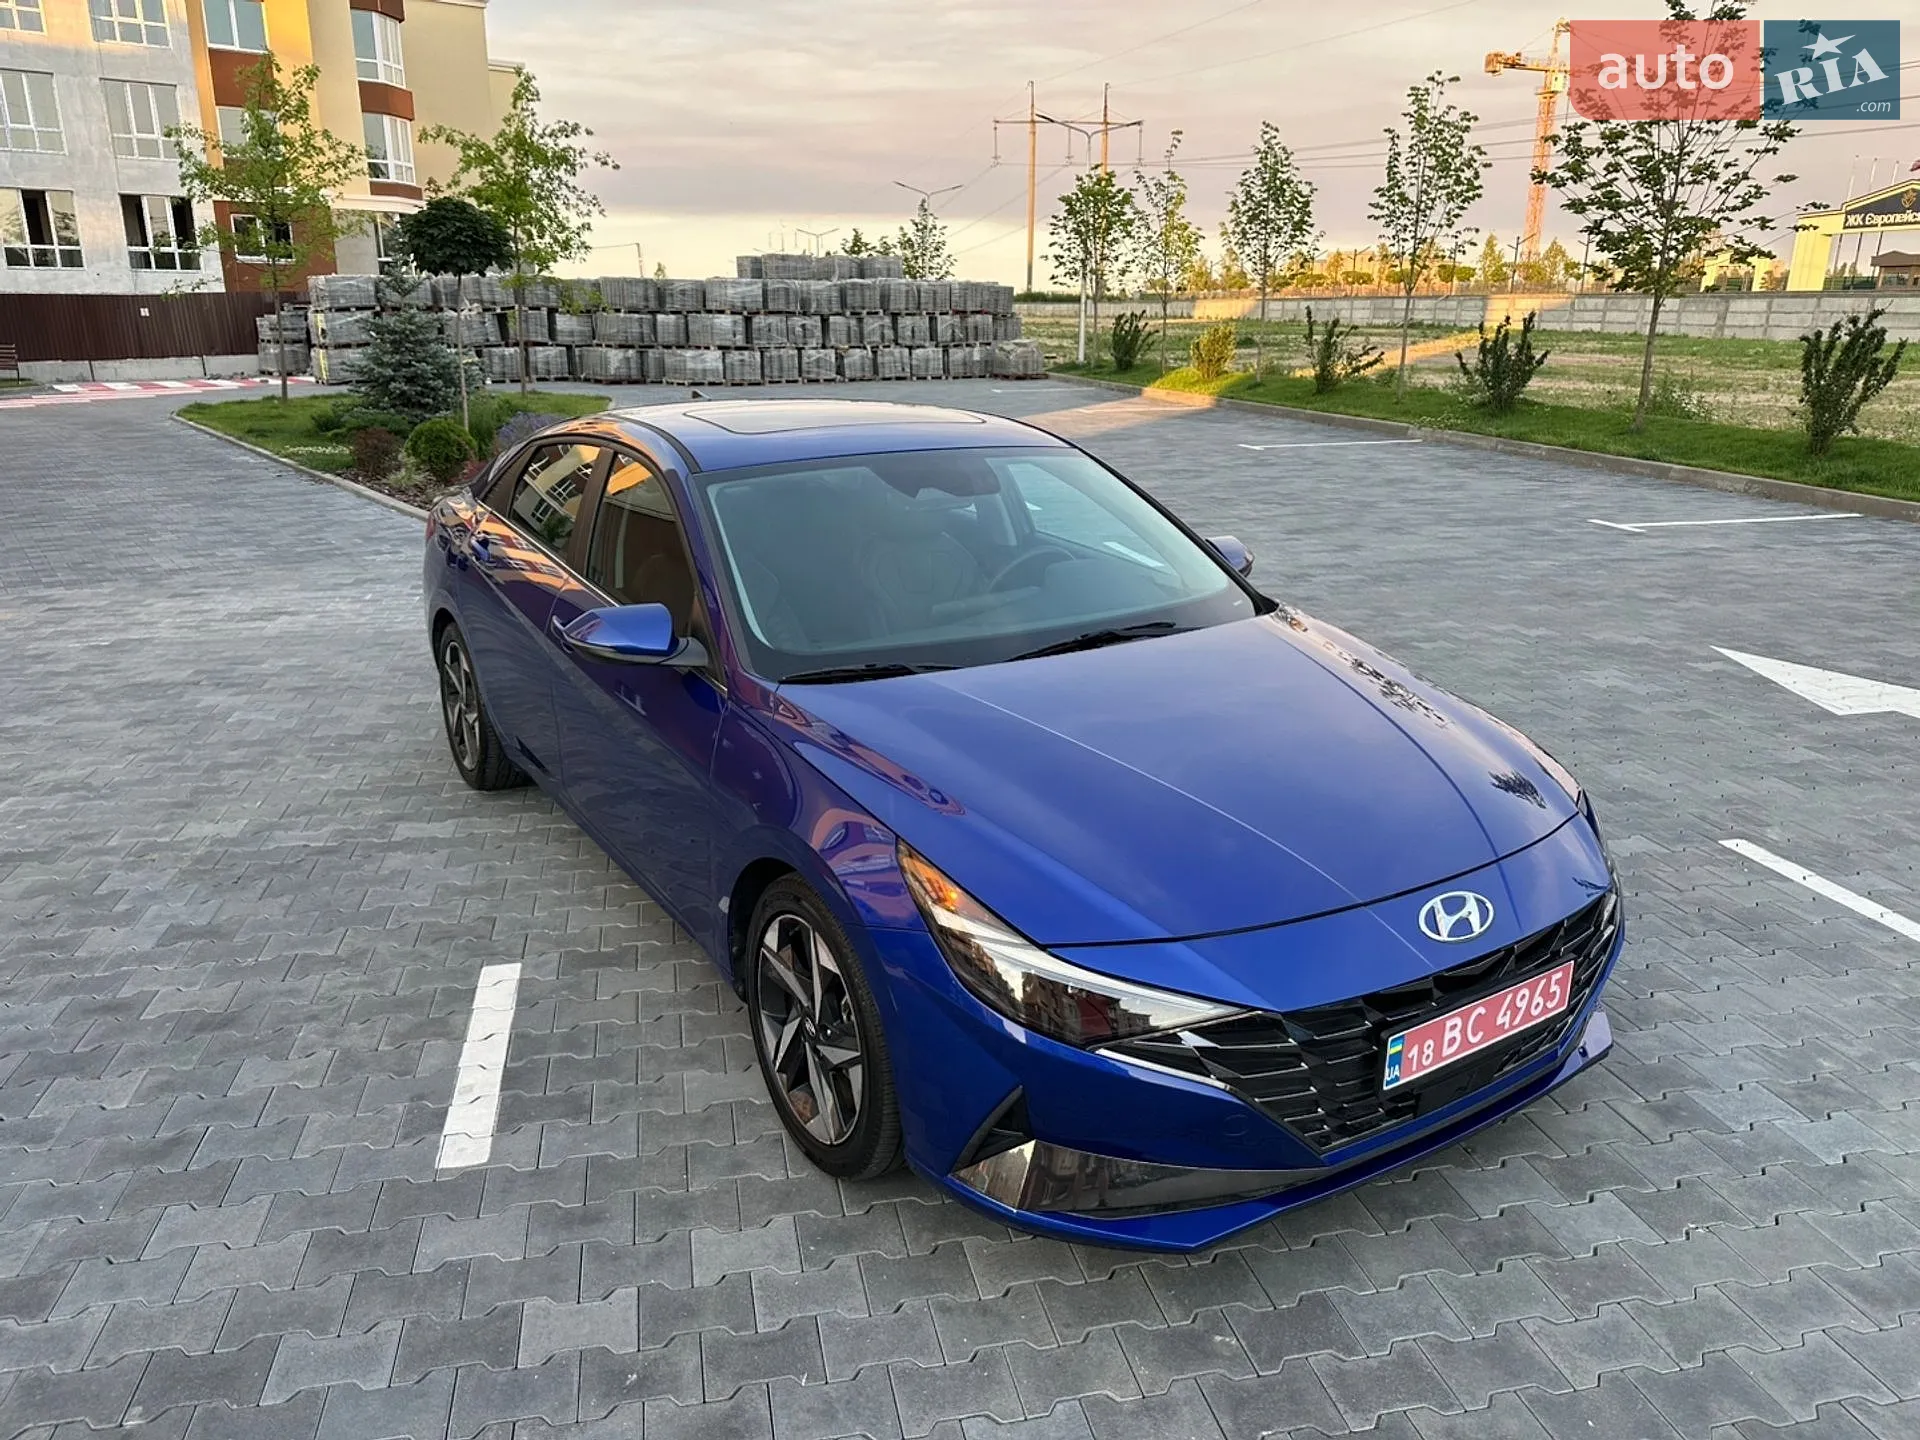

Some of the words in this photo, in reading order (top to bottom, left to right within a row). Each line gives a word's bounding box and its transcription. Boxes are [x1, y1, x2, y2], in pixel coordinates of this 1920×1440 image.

[1865, 210, 1920, 228] Європейс
[1407, 1039, 1434, 1071] 18
[1441, 1006, 1487, 1057] BC
[1496, 971, 1563, 1030] 4965
[1385, 1064, 1400, 1081] UA
